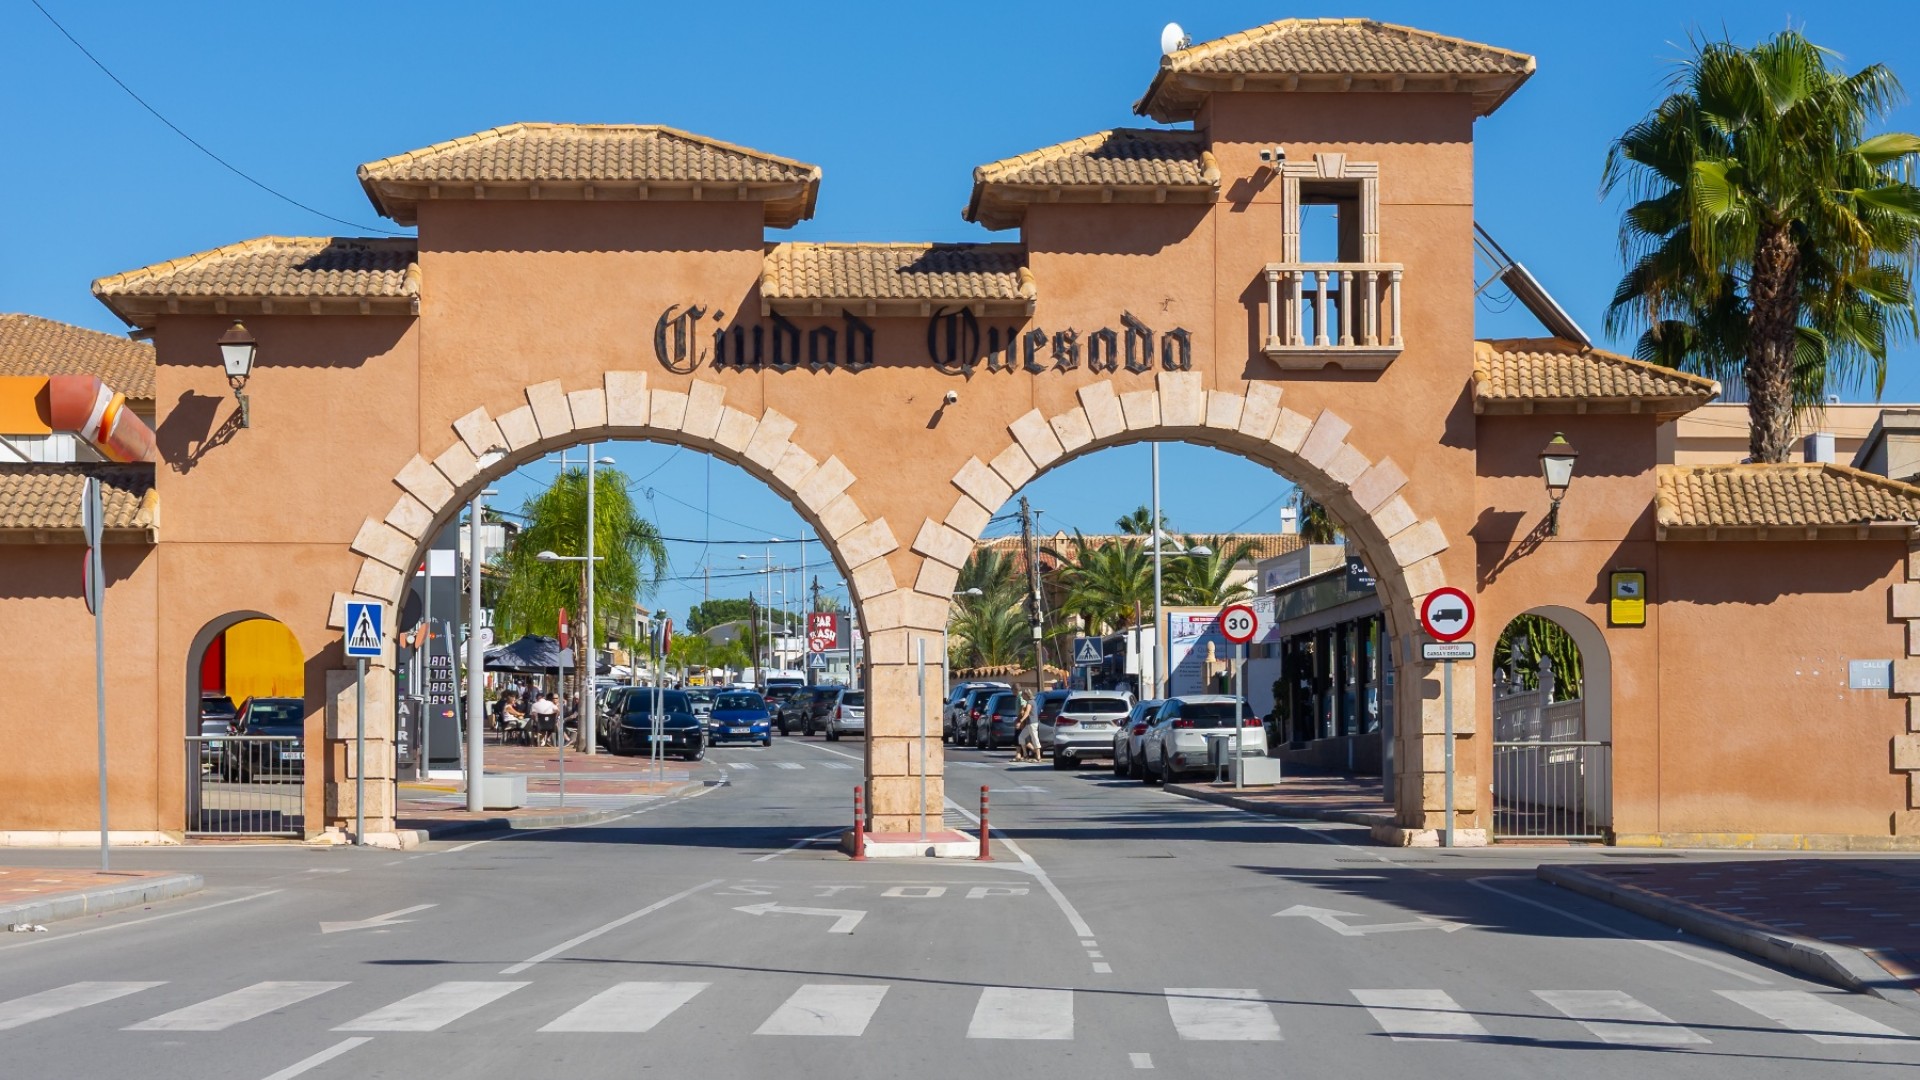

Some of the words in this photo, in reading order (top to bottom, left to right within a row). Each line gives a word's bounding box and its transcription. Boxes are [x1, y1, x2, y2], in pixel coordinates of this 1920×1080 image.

[654, 302, 877, 376] Ciudad
[927, 304, 1194, 384] Quesada
[1228, 618, 1249, 630] 30
[714, 885, 1030, 899] STOP
